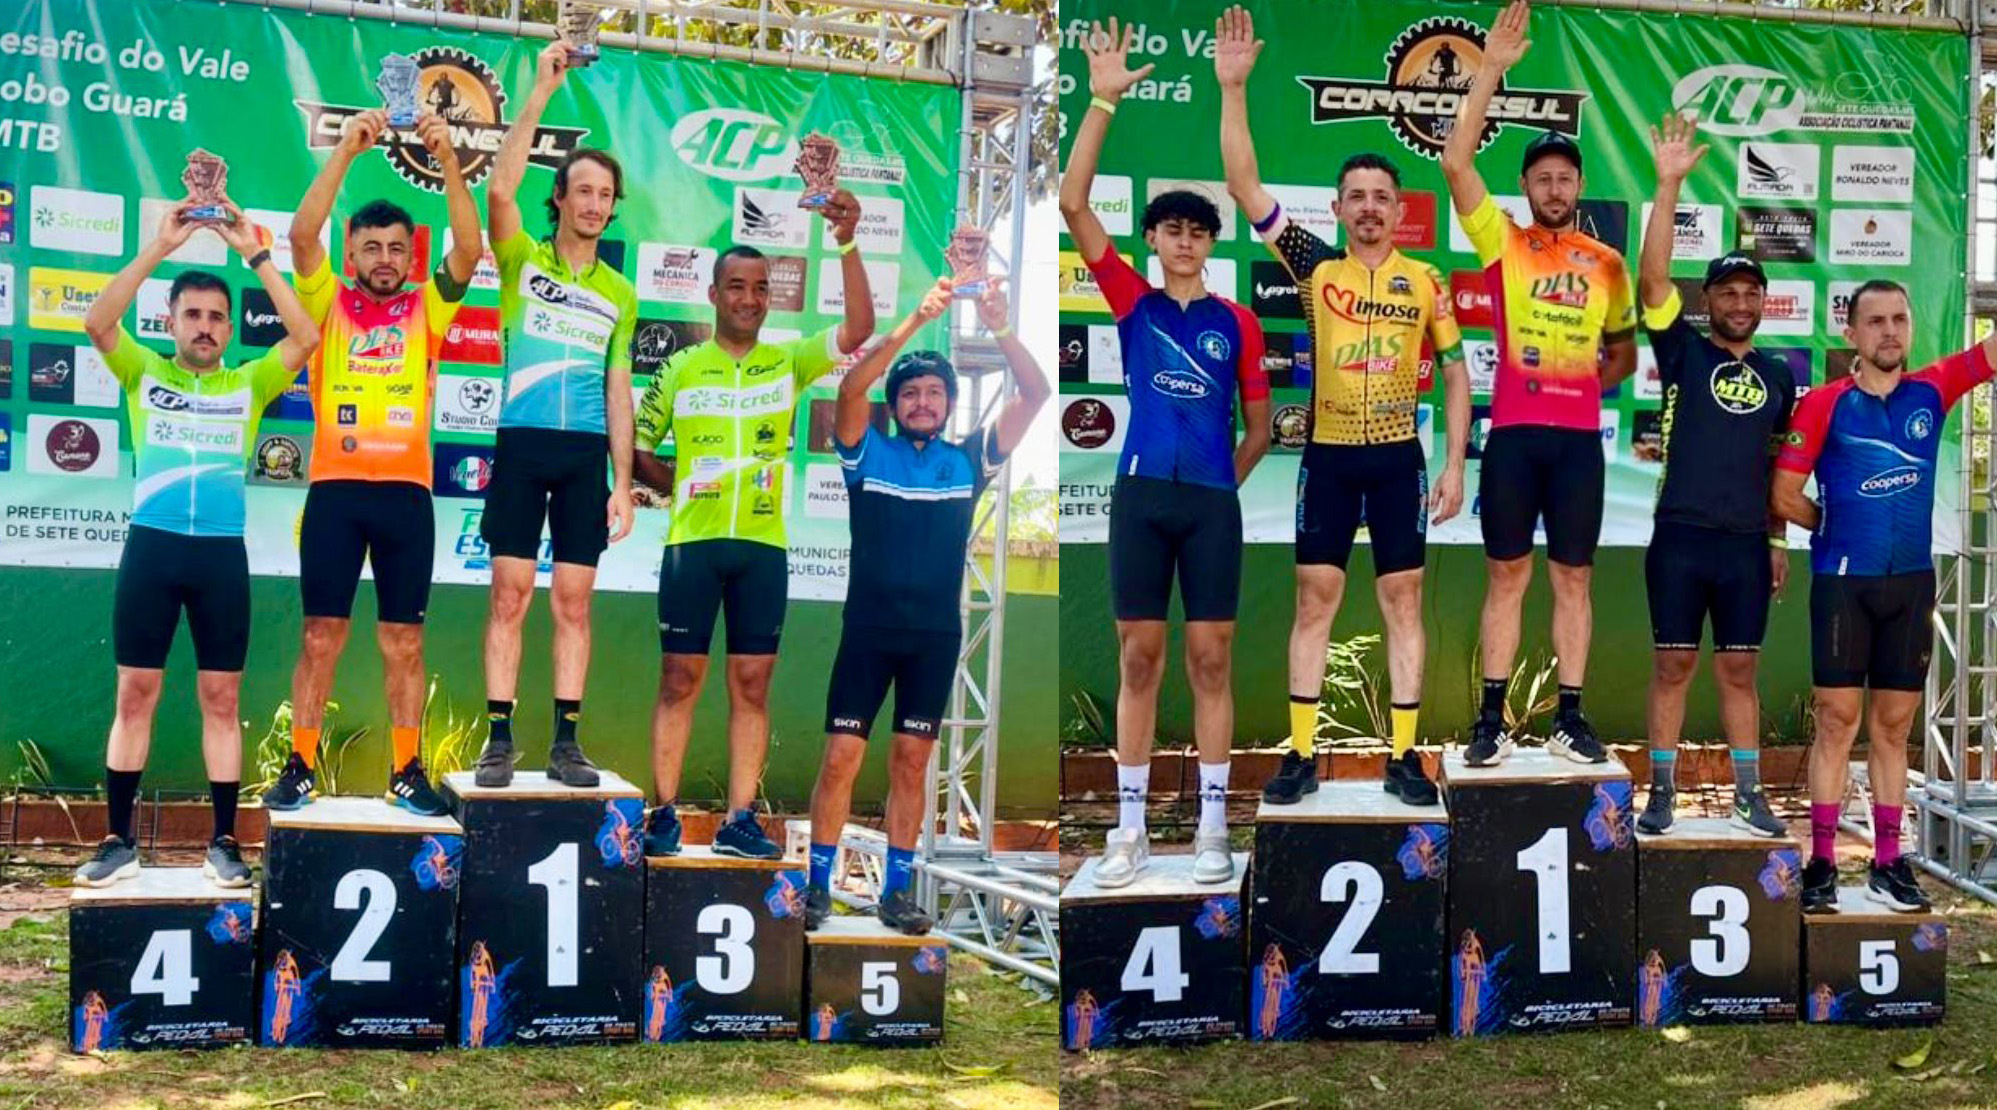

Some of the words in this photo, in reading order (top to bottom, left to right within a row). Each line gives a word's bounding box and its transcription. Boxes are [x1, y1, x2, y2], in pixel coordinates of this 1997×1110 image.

[118, 39, 165, 71] do
[178, 45, 250, 81] Vale
[1182, 29, 1217, 59] Va
[83, 82, 188, 122] Guará
[1319, 86, 1570, 121] COPACOESUL
[1676, 75, 1797, 125] ACP
[672, 117, 791, 170] ACP
[1836, 176, 1880, 184] RONALDO
[1850, 163, 1898, 172] VEREADOR
[58, 211, 120, 233] Sicredi
[863, 214, 888, 224] ADOR
[872, 228, 899, 237] NEVES
[1850, 240, 1892, 248] VEREADOR
[1715, 378, 1765, 406] MTB
[177, 427, 238, 447] Sicredi
[6, 504, 116, 524] PREFEITURA
[808, 492, 839, 502] PAULO
[5, 524, 31, 538] DE
[34, 525, 79, 541] SETE
[528, 842, 579, 987] 1
[1318, 860, 1384, 974] 2
[1516, 826, 1571, 974] 1
[330, 868, 397, 982] 2
[1689, 884, 1750, 977] 3
[695, 903, 755, 994] 3
[1120, 925, 1190, 1003] 4
[130, 929, 199, 1006] 4
[1859, 939, 1900, 996] 5
[860, 961, 900, 1016] 5
[531, 1015, 619, 1026] BICICLETARIA
[1524, 1000, 1613, 1013] BICICLETARIA
